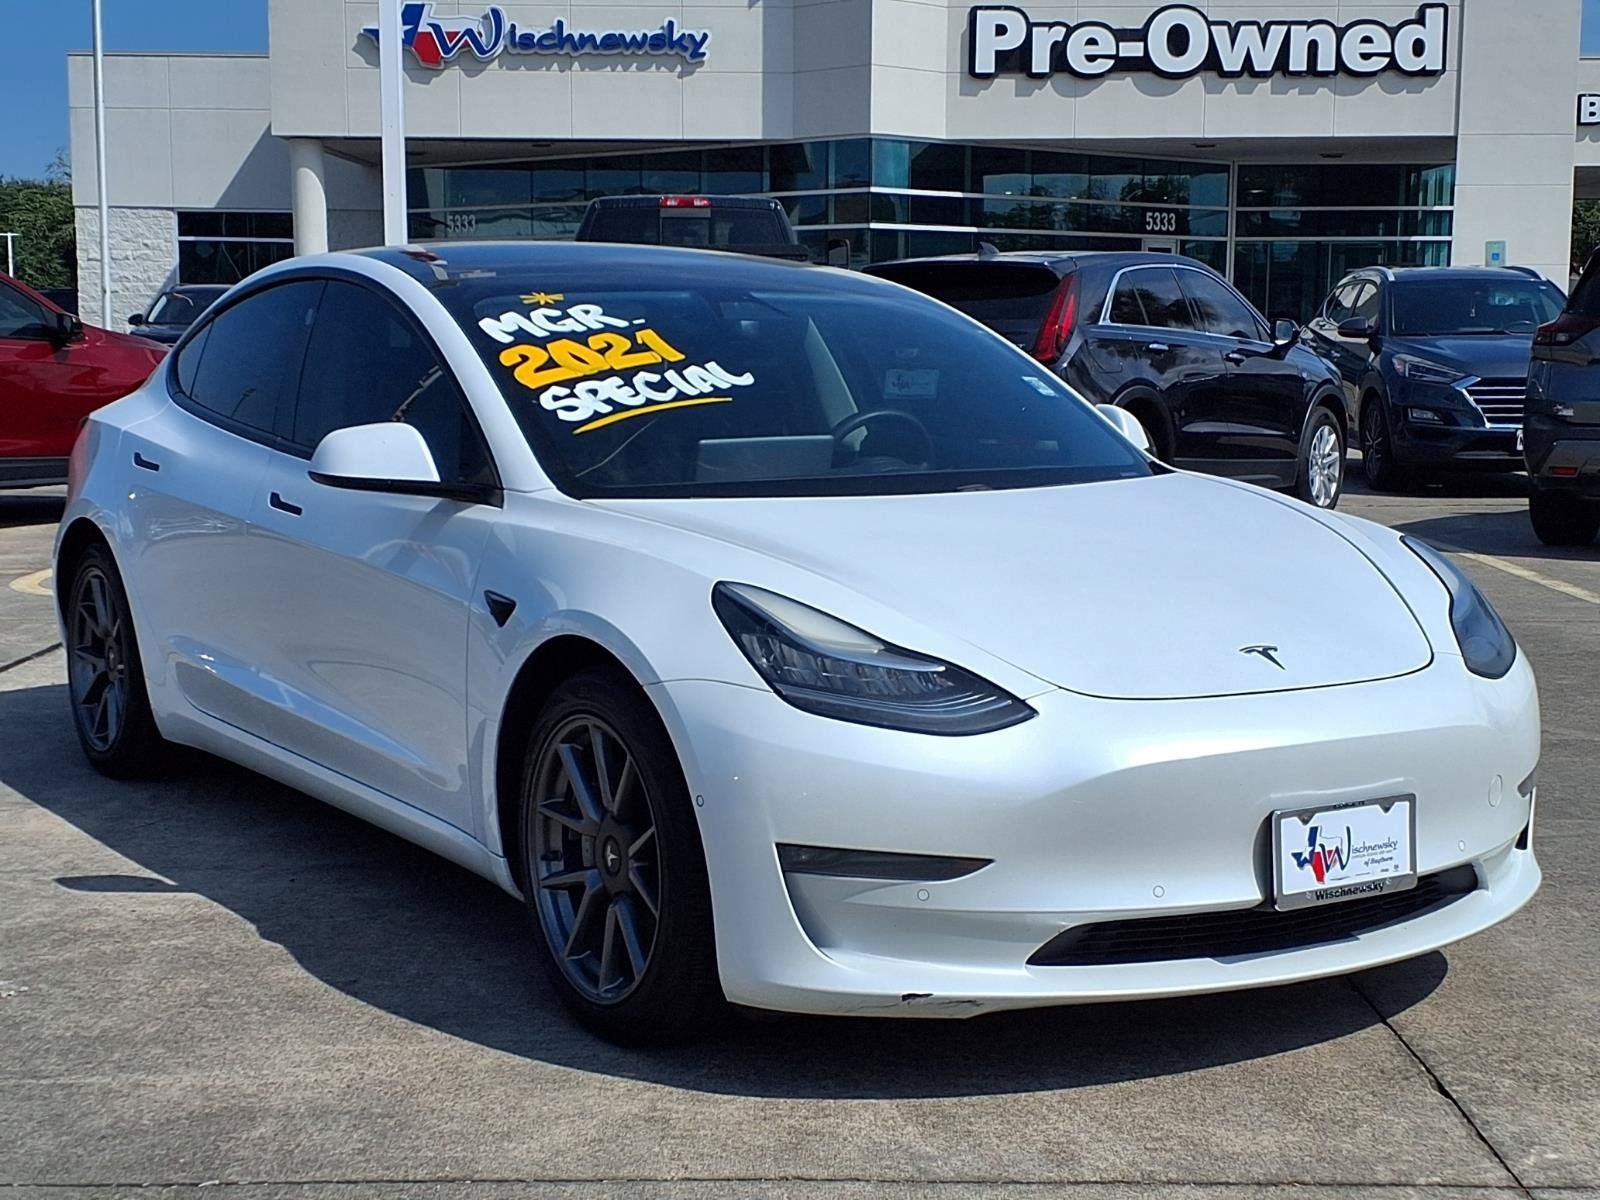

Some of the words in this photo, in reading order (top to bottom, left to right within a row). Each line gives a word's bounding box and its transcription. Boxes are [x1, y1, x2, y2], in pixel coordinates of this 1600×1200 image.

[426, 5, 709, 60] Wischnewsky
[969, 3, 1449, 78] Pre-Owned
[447, 214, 476, 232] 5333
[1145, 211, 1176, 231] 5333
[499, 328, 686, 389] 2021
[539, 361, 755, 422] SPECIAL
[1319, 825, 1398, 873] Wischnewsky
[1315, 880, 1385, 901] Wischnewsky
